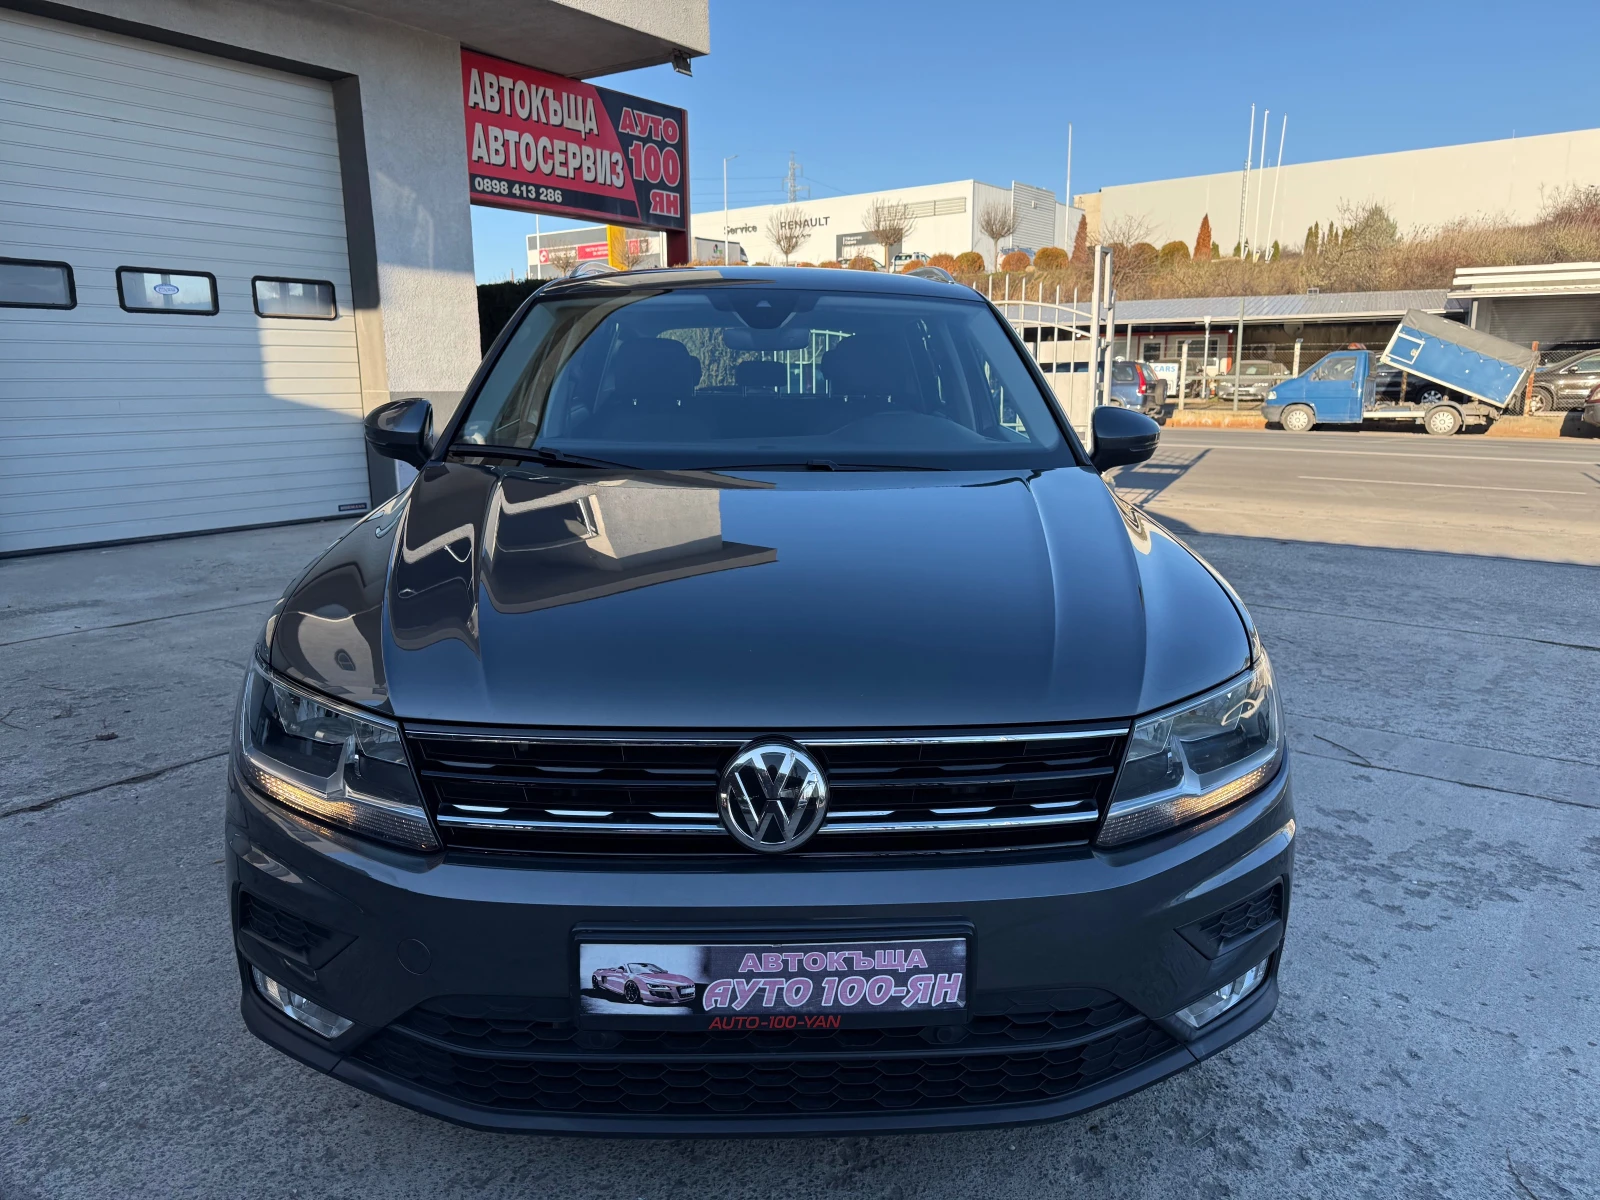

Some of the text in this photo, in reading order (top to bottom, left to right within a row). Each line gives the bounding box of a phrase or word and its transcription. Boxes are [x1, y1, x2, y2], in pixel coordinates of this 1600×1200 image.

[468, 68, 599, 139] АВТОКЪЩА
[619, 106, 679, 144] АУТО
[471, 122, 626, 188] АВТОСЕРВИЗ
[628, 142, 681, 187] 100
[474, 176, 563, 203] 0898 413 286
[649, 189, 681, 218] ЯН
[724, 222, 757, 236] Service
[780, 216, 830, 231] RENAULT
[1154, 365, 1176, 373] CARS
[737, 948, 929, 974] АВТОКЪЩА
[702, 972, 963, 1012] АУТО 100-ЯН
[708, 1015, 842, 1031] AUTO-100-YAN
